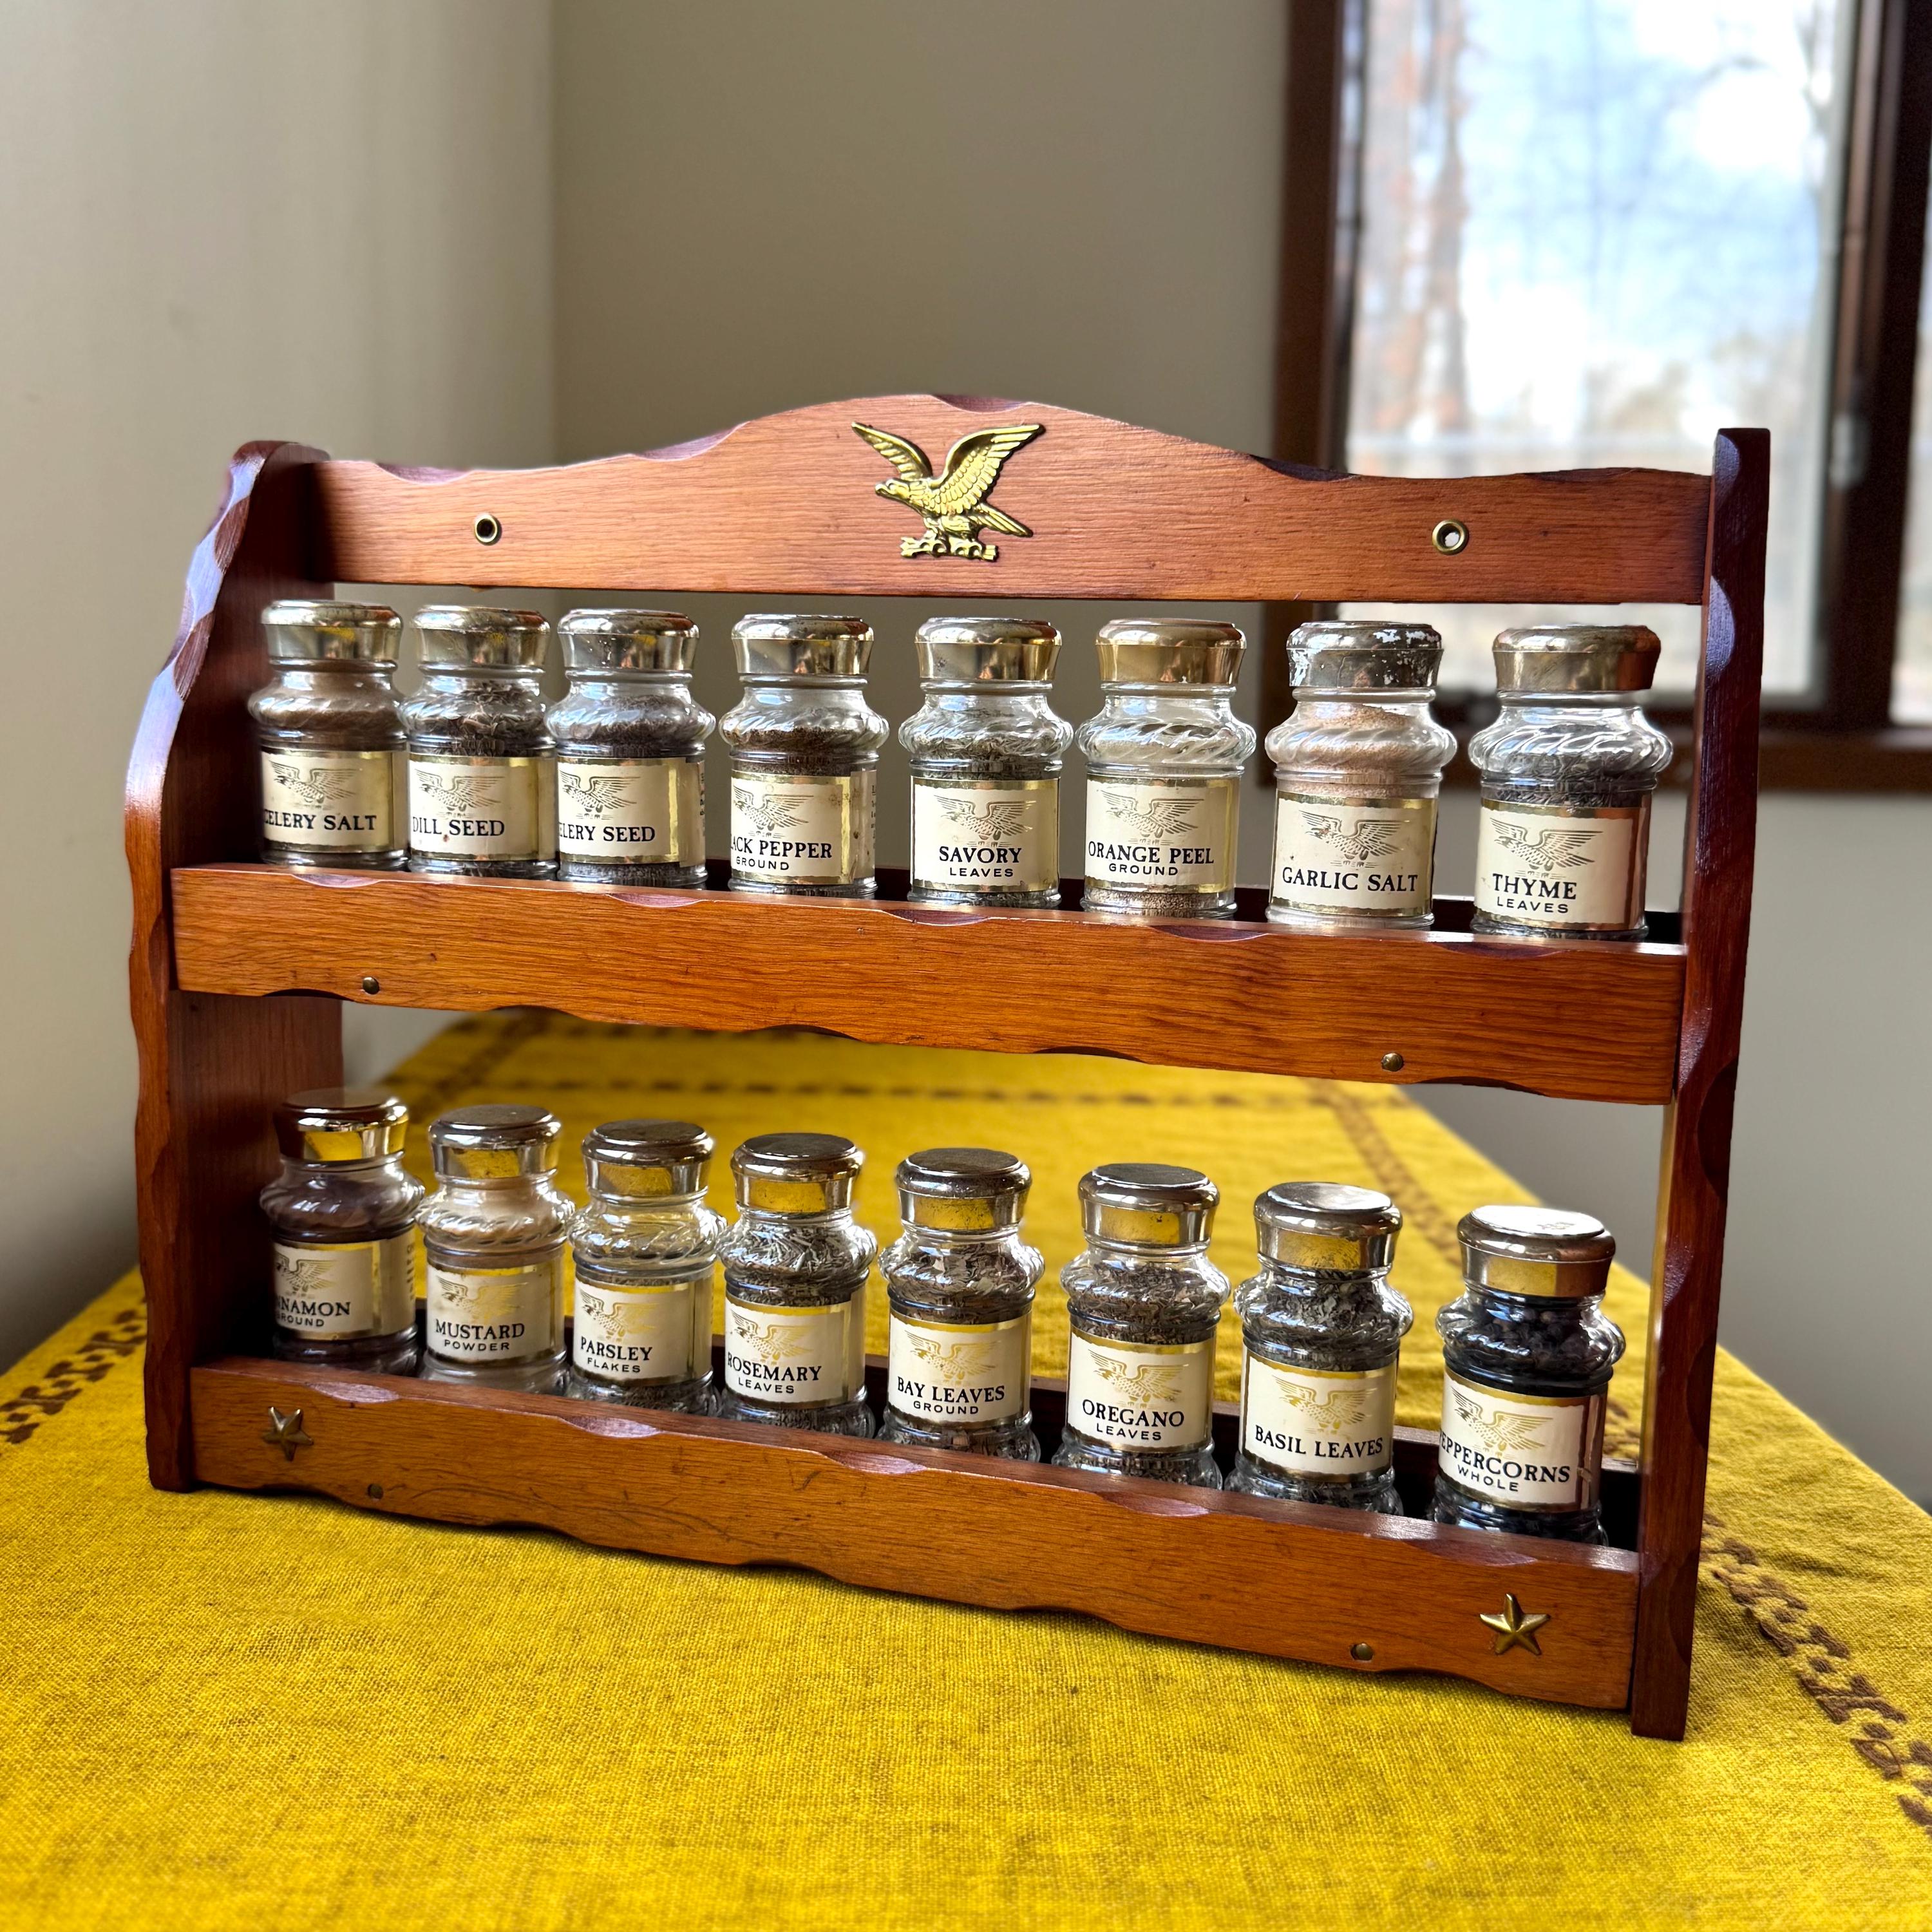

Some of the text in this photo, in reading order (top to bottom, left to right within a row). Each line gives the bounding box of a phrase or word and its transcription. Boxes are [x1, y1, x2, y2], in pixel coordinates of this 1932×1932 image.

[324, 815, 377, 831] SALT
[413, 817, 505, 837] DILL SEED
[558, 821, 656, 842] ELERY SEED
[730, 836, 832, 858] ACK PEPPER
[939, 846, 1022, 864] SAVORY
[1088, 841, 1214, 864] ORANGE PEEL
[736, 856, 790, 871] GROUND
[949, 867, 1014, 877] LEAVES
[1109, 863, 1179, 876] GROUND
[1282, 867, 1418, 891] GARLIC SALT
[1492, 873, 1577, 900] THYME
[1497, 896, 1569, 913] LEAVES
[278, 1295, 351, 1316] NAMON
[435, 1318, 525, 1340] MUSTARD
[444, 1339, 510, 1351] POWDER
[581, 1336, 653, 1361] PARSLEY
[587, 1357, 641, 1373] FLAKES
[728, 1351, 822, 1381] ROSEMARY
[738, 1377, 794, 1394] LEAVES
[897, 1376, 1005, 1403] BAY LEAVES
[913, 1401, 979, 1415] GROUND
[1082, 1399, 1184, 1427] OREGANO
[1096, 1423, 1162, 1441] LEAVES
[1255, 1425, 1383, 1459] BASIL LEAVES
[1457, 1464, 1519, 1492] WHOLE
